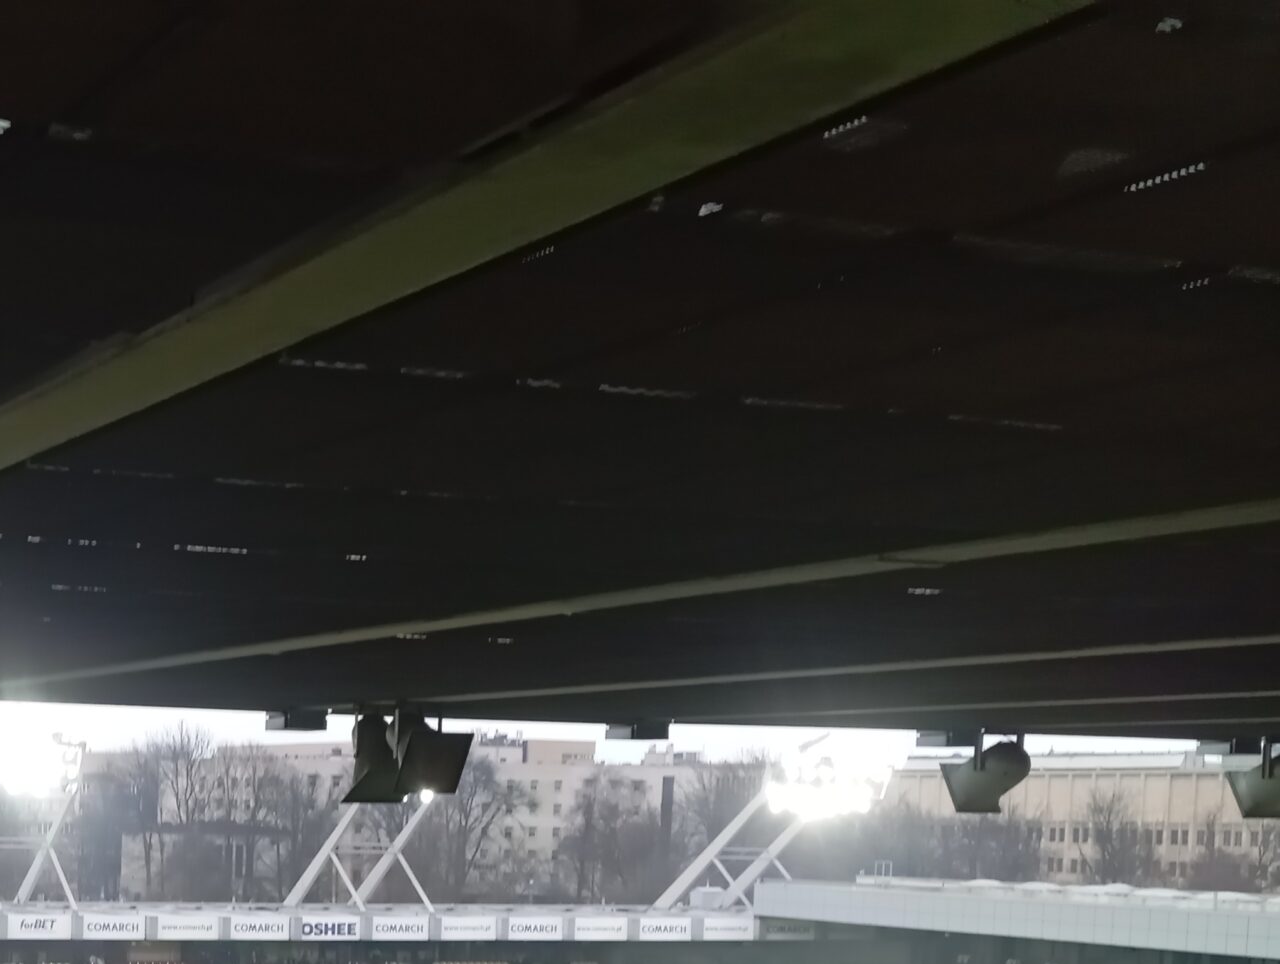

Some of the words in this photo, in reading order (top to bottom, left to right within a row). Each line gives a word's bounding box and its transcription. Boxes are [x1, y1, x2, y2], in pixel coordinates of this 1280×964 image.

[87, 922, 139, 932] COMARCH
[234, 923, 284, 933] COMARCH
[302, 922, 357, 935] OSHEE
[375, 923, 424, 934] COMARCH
[511, 924, 558, 934] COMARCH
[641, 925, 687, 934] COMARCH
